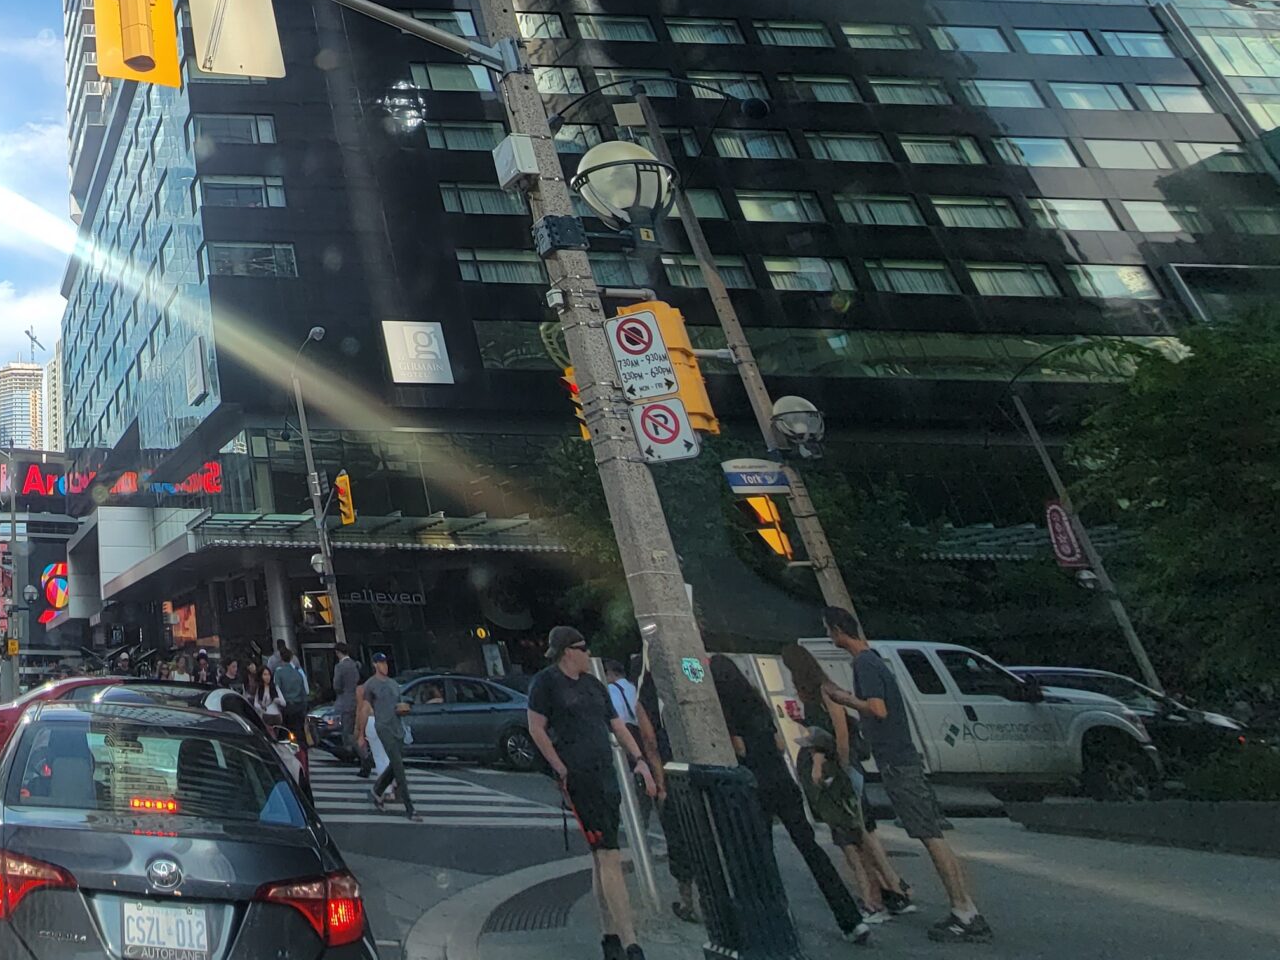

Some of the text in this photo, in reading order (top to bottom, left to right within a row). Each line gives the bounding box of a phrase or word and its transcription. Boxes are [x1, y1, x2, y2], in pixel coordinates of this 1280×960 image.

[740, 473, 764, 484] York
[126, 914, 207, 950] CSZL 012
[141, 946, 208, 960] AUTOPLANET
